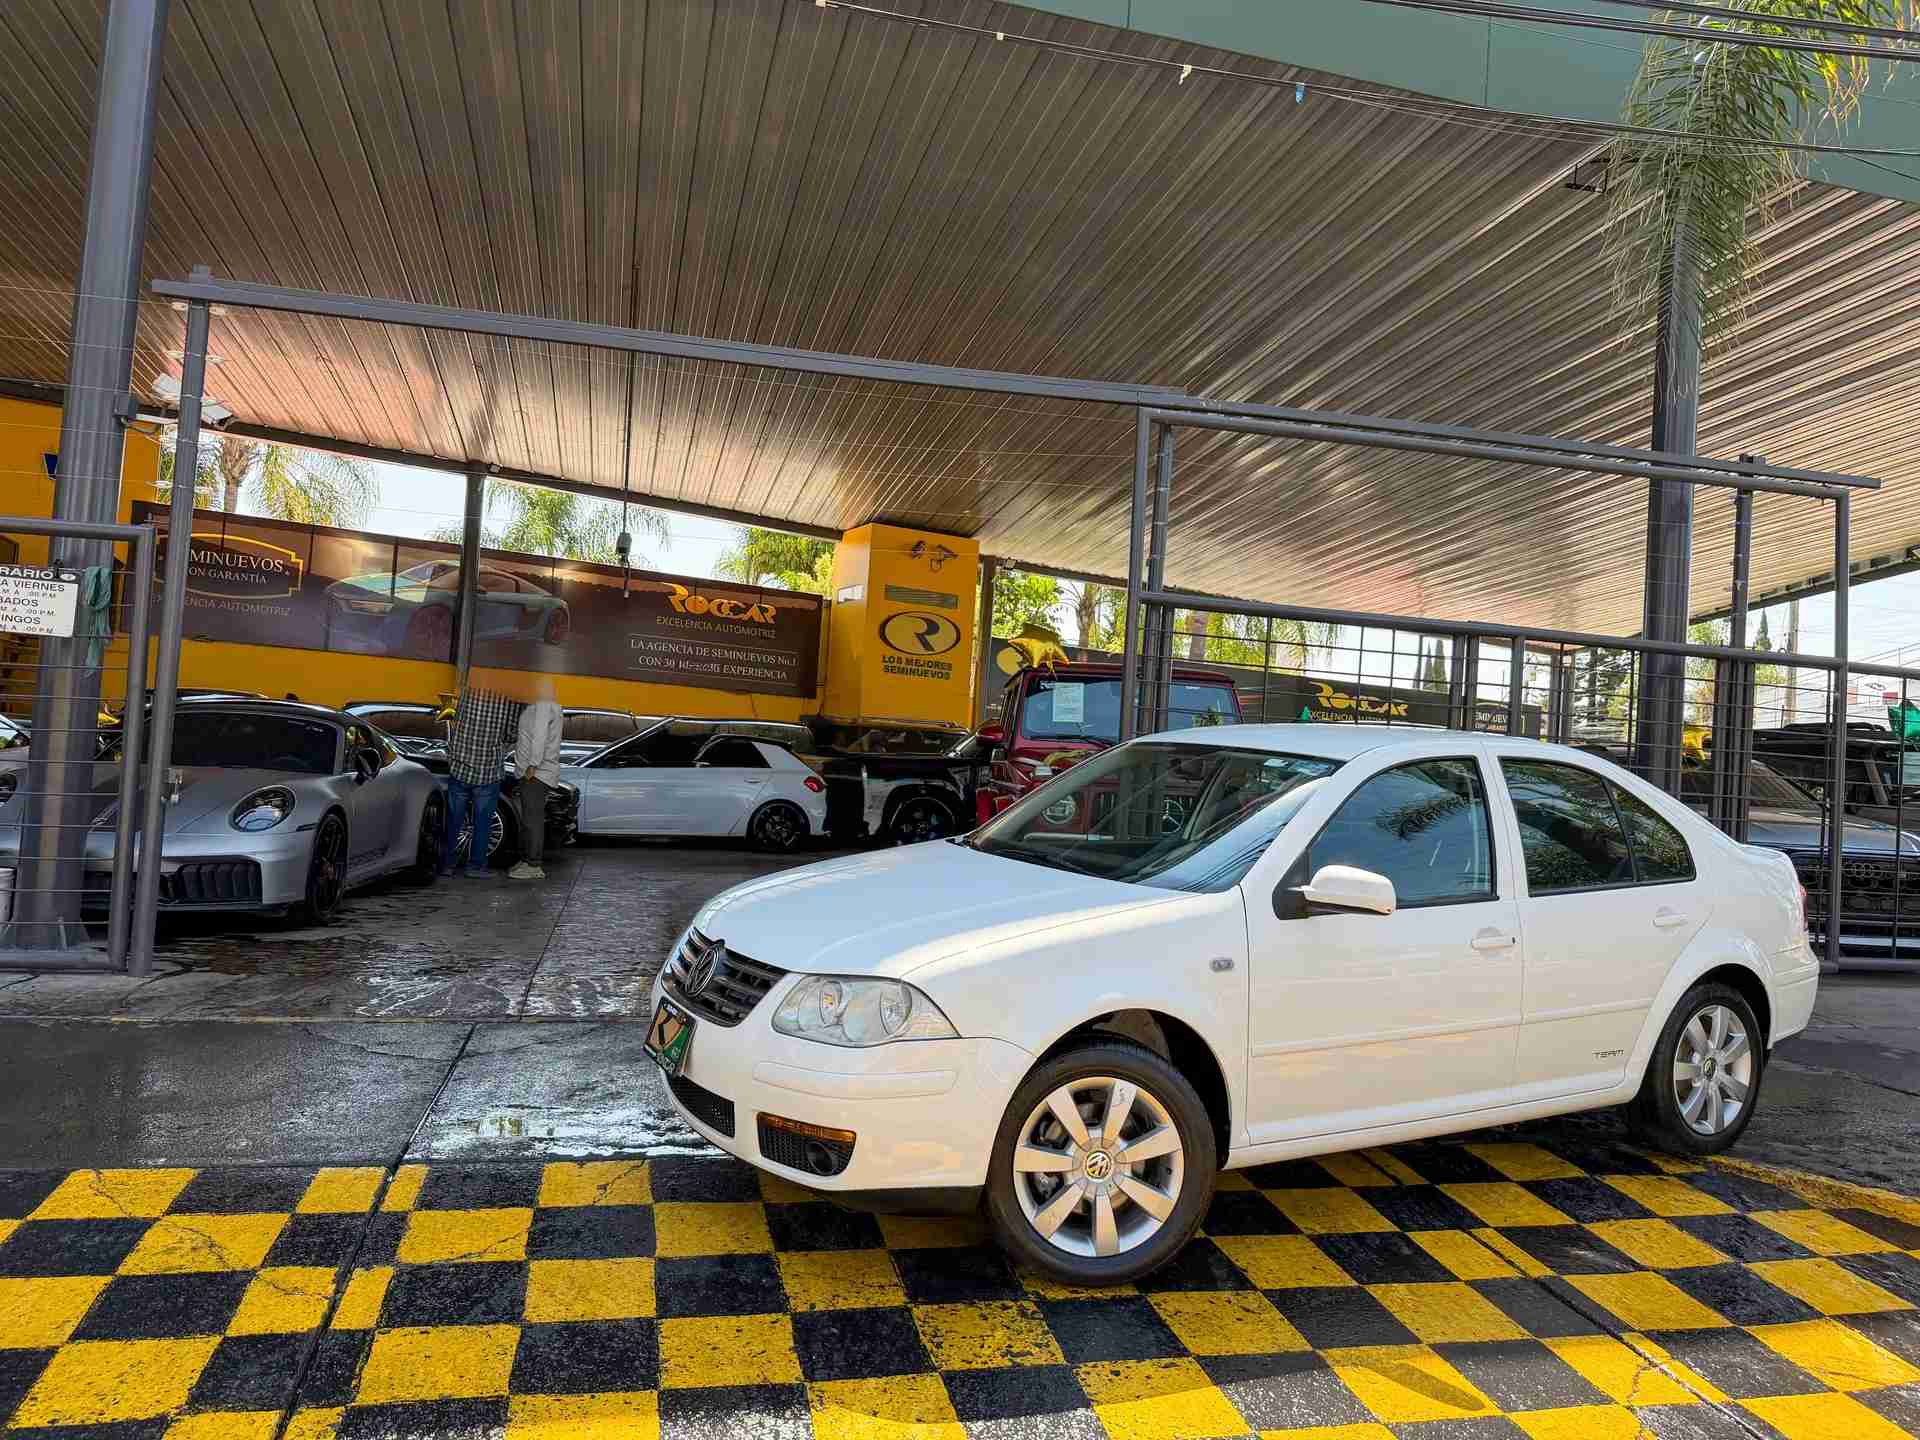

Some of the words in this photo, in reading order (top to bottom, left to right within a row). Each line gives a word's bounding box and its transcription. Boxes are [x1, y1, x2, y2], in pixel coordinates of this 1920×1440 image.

[190, 550, 284, 573] MINUEVOS
[189, 566, 206, 577] ON
[208, 569, 268, 585] GARANTÍA
[15, 581, 65, 592] VIERNES
[663, 581, 777, 624] ROCCAR
[656, 615, 713, 632] EXCELENCIA
[715, 623, 777, 639] AUTOMOTRIZ
[631, 639, 646, 650] LA
[647, 640, 694, 656] AGENCIA
[695, 646, 711, 657] DE
[711, 647, 776, 665] SEMINUEVOS
[638, 655, 663, 667] CON
[723, 663, 788, 681] EXPERIENCIA
[882, 655, 903, 665] LOS
[905, 656, 953, 672] MEJORES
[883, 665, 952, 681] SEMINUEVOS
[1310, 711, 1354, 721] XCELENCIA
[1591, 1049, 1625, 1059] TEAM
